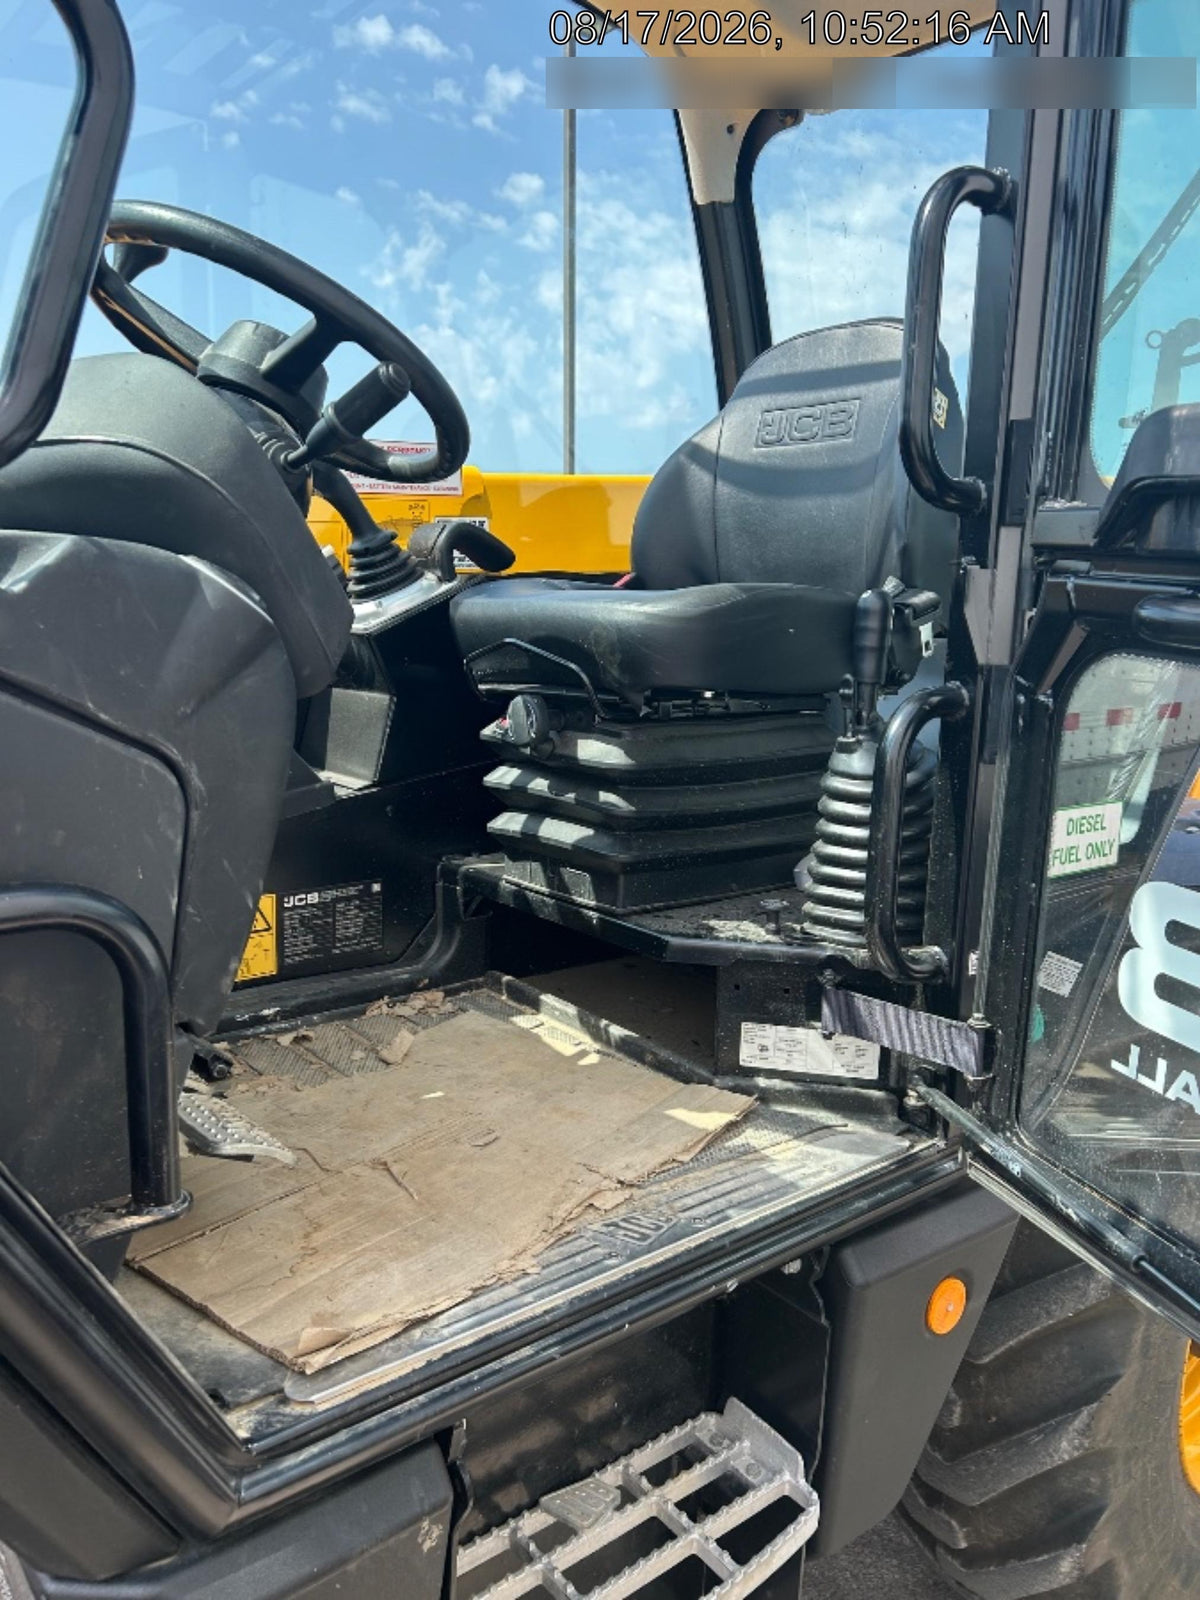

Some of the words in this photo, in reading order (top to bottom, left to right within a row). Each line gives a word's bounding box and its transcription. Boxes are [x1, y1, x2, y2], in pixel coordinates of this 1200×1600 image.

[757, 402, 858, 447] JCB
[1066, 813, 1107, 836] DIESEL
[1052, 844, 1082, 867] FUEL
[1085, 838, 1116, 860] ONLY
[284, 892, 319, 907] JCB
